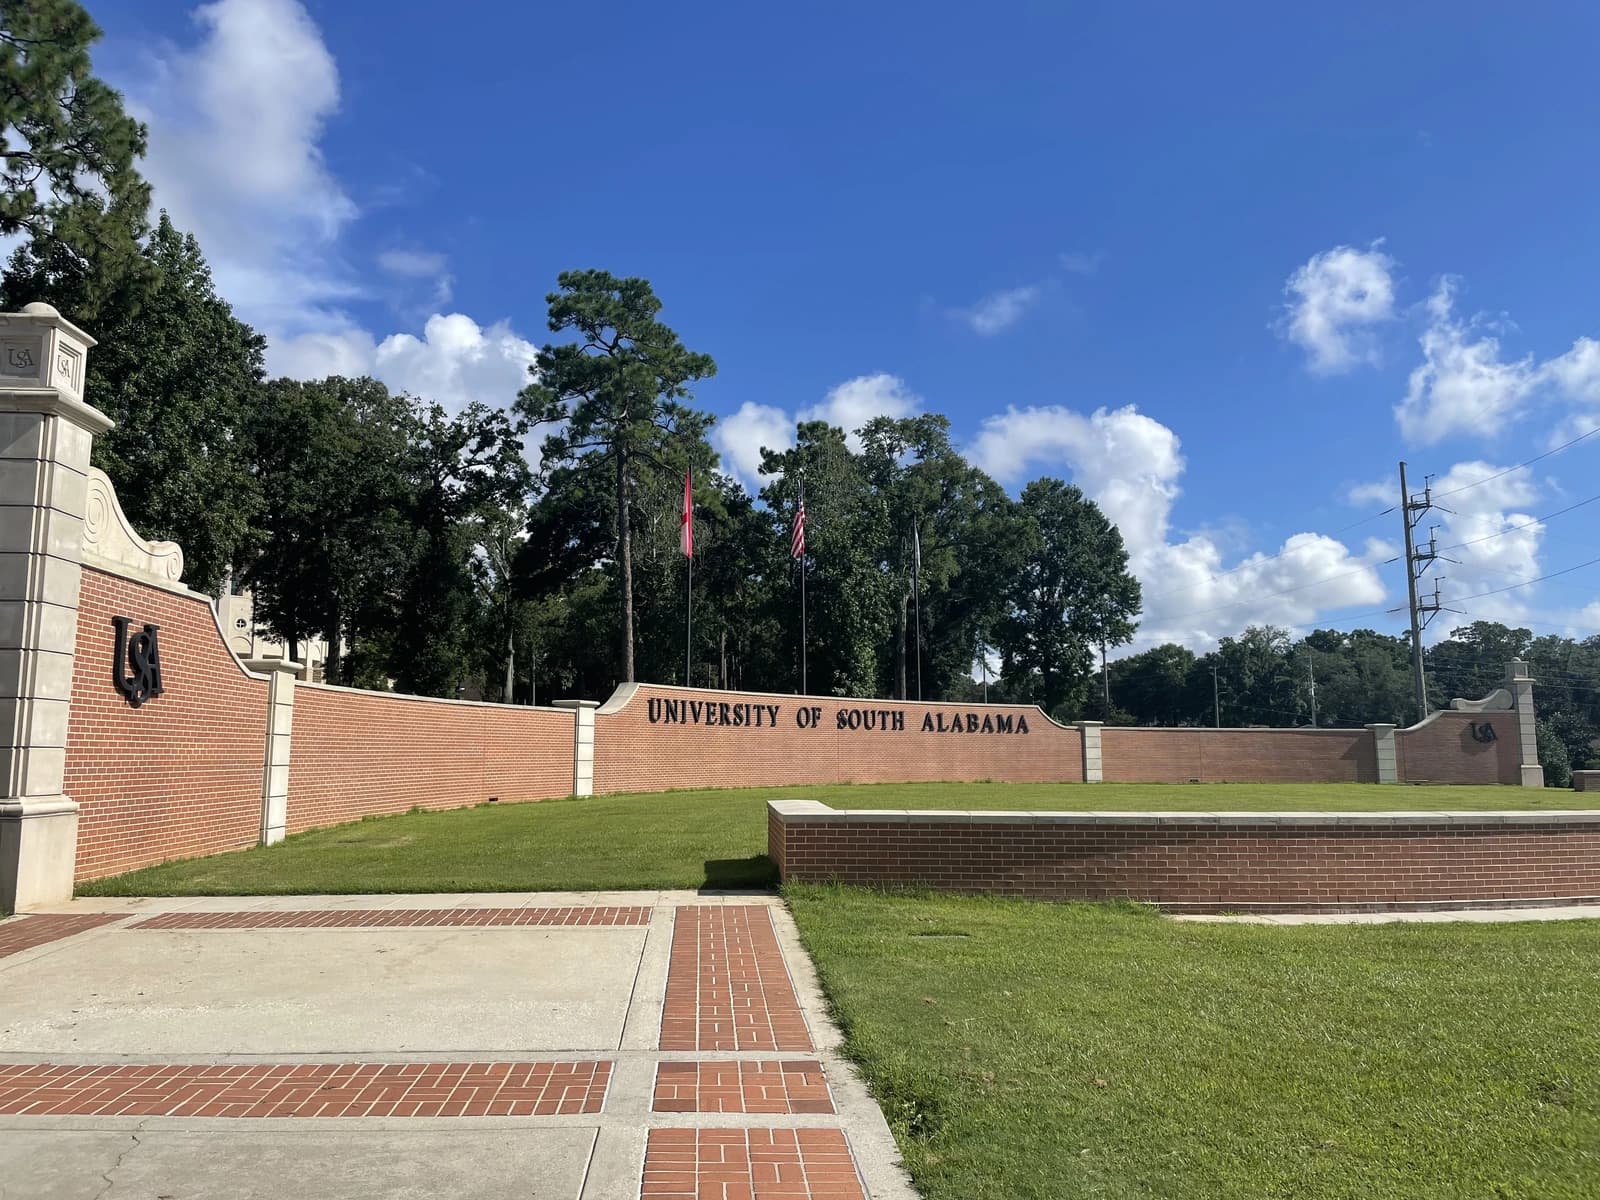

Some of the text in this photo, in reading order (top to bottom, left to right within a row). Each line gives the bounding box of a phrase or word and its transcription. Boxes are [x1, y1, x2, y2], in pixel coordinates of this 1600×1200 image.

[7, 348, 36, 368] USA
[56, 354, 71, 379] USA
[112, 615, 164, 709] USA
[648, 697, 1030, 734] UNIVERSITY OF SOUTH ALABAMA
